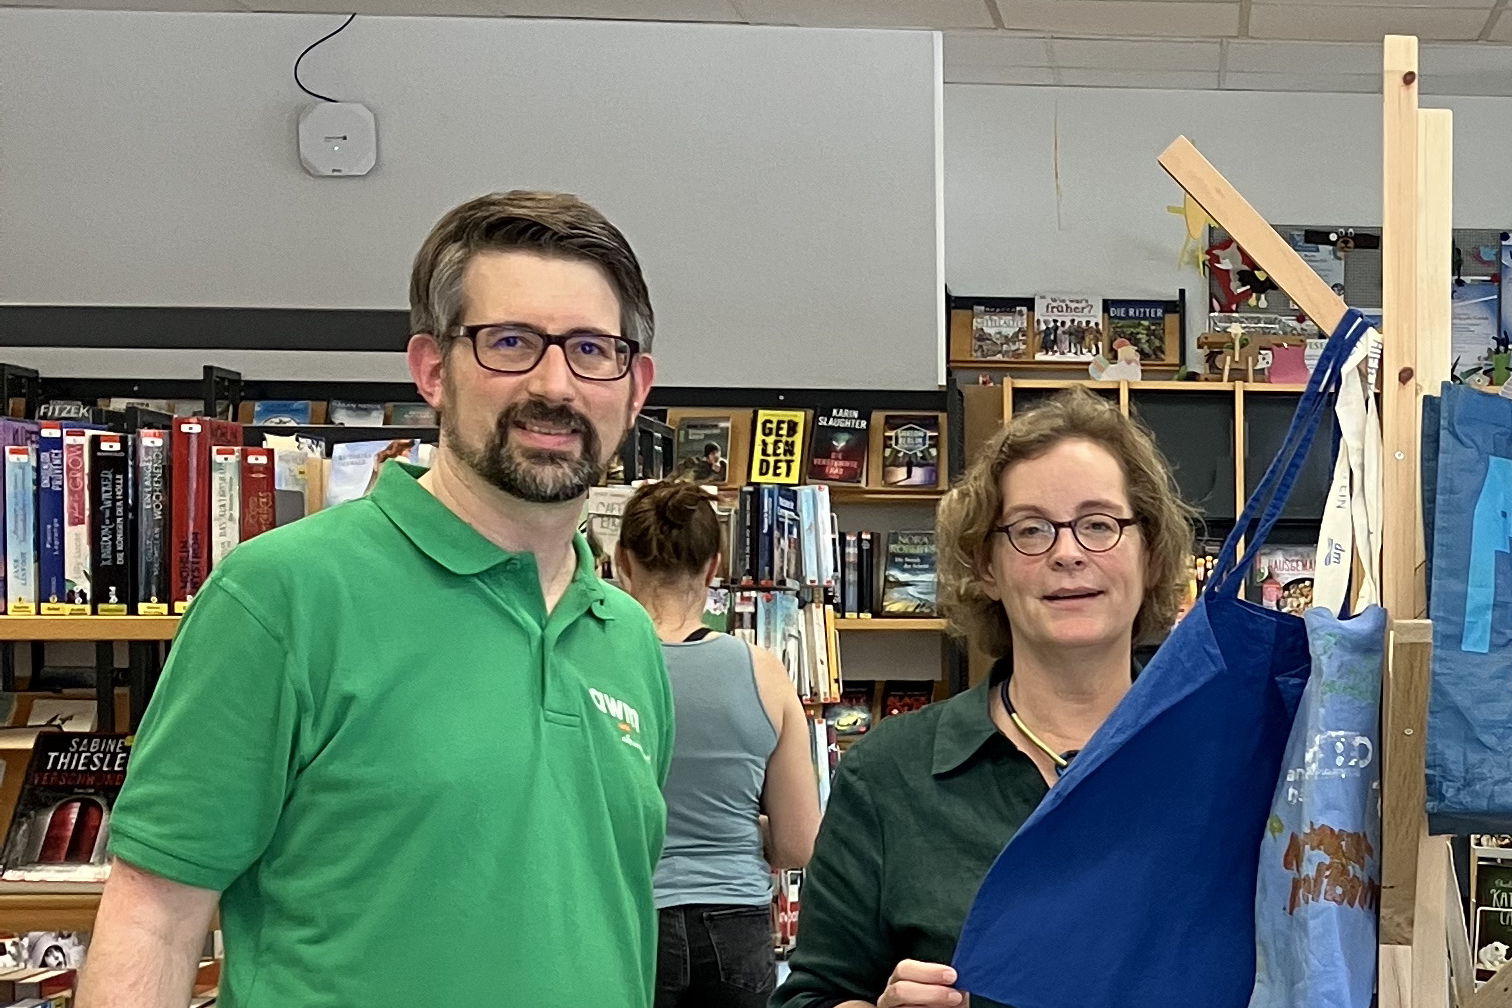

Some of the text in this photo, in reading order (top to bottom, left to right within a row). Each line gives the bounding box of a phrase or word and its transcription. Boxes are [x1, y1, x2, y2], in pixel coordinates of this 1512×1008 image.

[1045, 302, 1094, 315] früher?
[1110, 307, 1164, 318] DIE RITTER
[39, 404, 90, 418] FITZEK
[832, 408, 859, 418] KARIN
[761, 419, 799, 437] GEB
[818, 416, 867, 429] SLAUGHTER
[761, 439, 795, 457] LEN
[68, 446, 83, 491] GROW
[759, 459, 795, 478] DET
[1332, 542, 1346, 565] dm
[69, 738, 125, 753] SABINE
[46, 752, 127, 771] THIESLE
